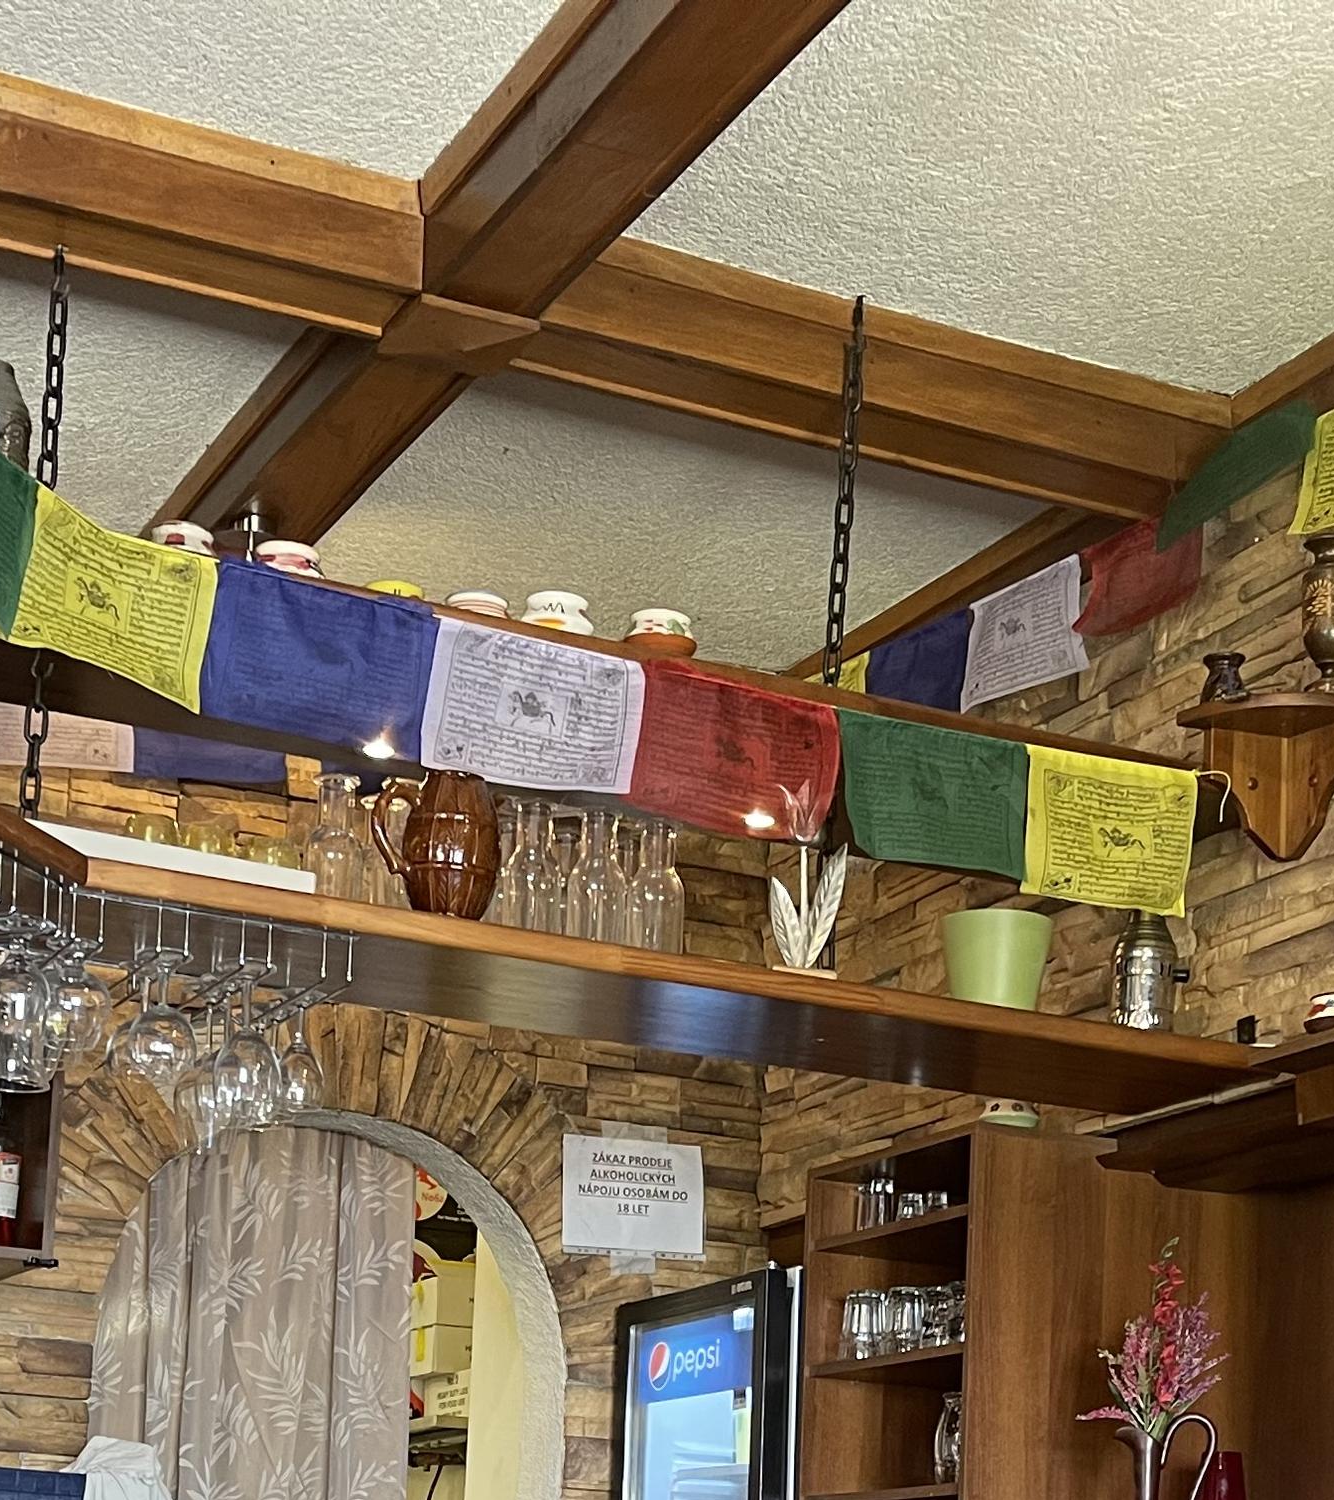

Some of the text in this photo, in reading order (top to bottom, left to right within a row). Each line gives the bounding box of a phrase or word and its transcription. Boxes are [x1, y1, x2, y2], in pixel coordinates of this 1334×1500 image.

[592, 1151, 673, 1168] ZÁKAZ PRODEJE
[590, 1169, 676, 1184] ALKOHOLICKÝCH
[623, 1187, 670, 1200] OSOBÁM
[672, 1191, 688, 1200] DO
[618, 1203, 650, 1214] 18 LET
[672, 1338, 720, 1382] pepsi
